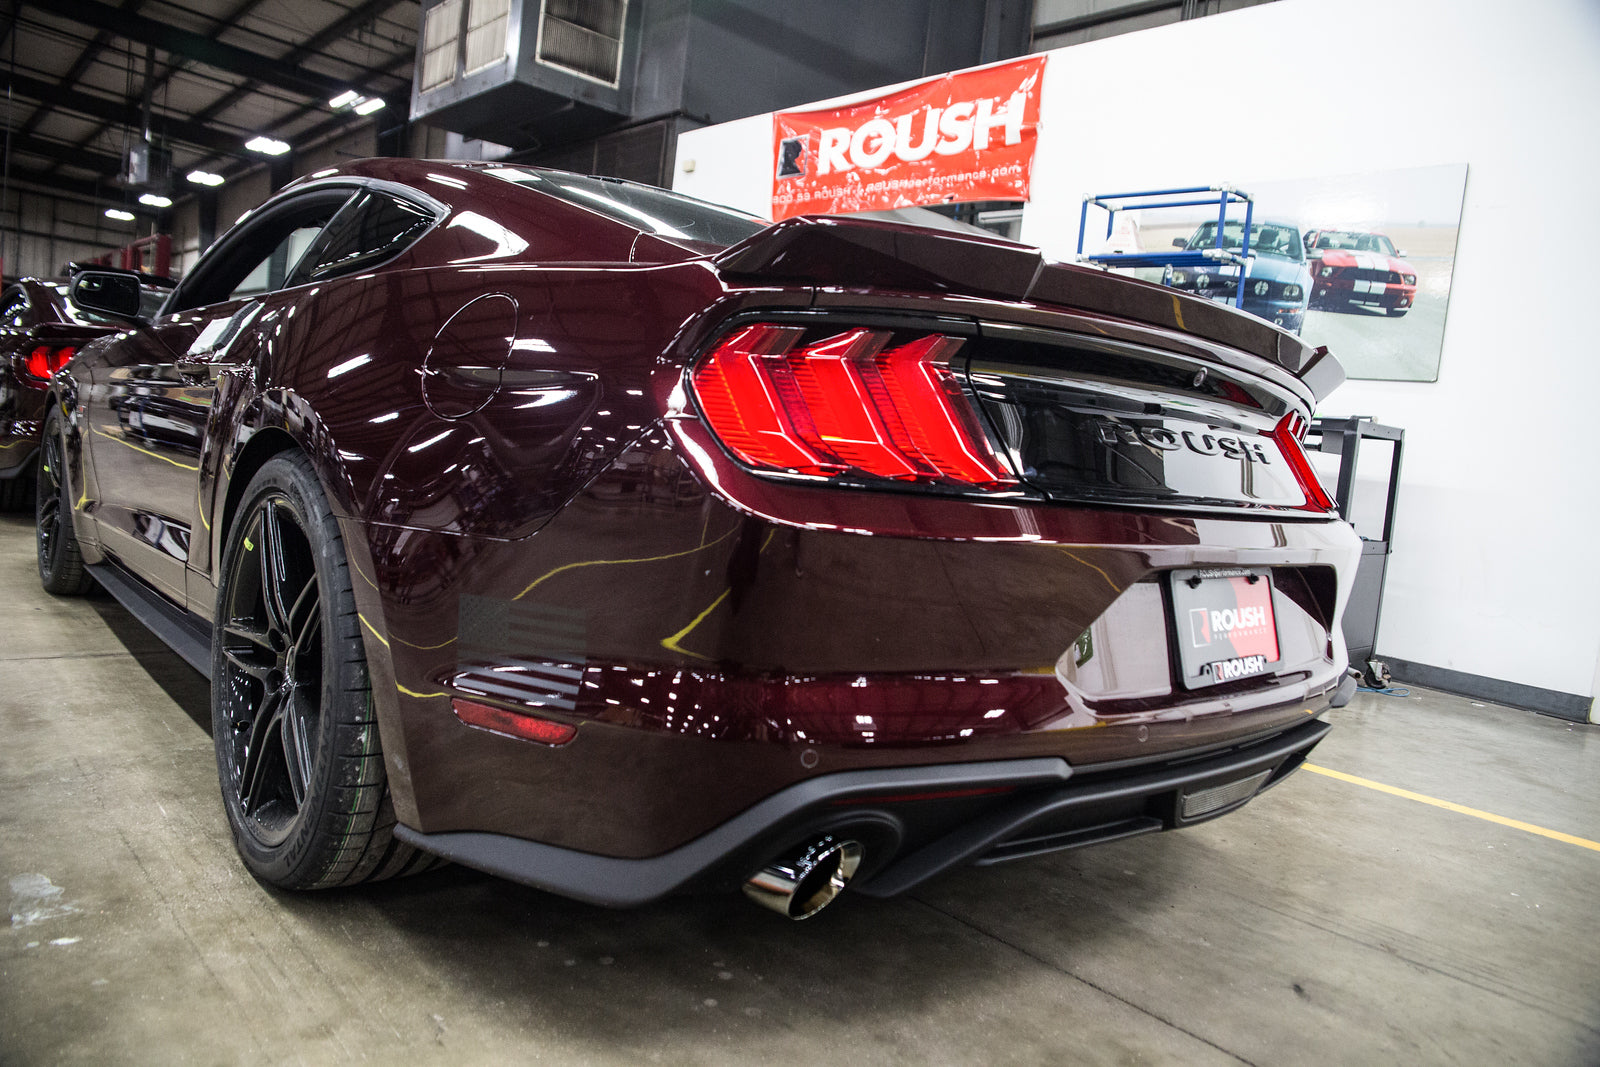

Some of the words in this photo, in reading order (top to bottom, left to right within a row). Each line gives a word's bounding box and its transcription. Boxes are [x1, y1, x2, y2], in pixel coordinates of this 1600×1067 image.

[816, 93, 1026, 175] ROUSH
[1211, 606, 1266, 632] ROUSH
[1223, 656, 1264, 678] ROUSH
